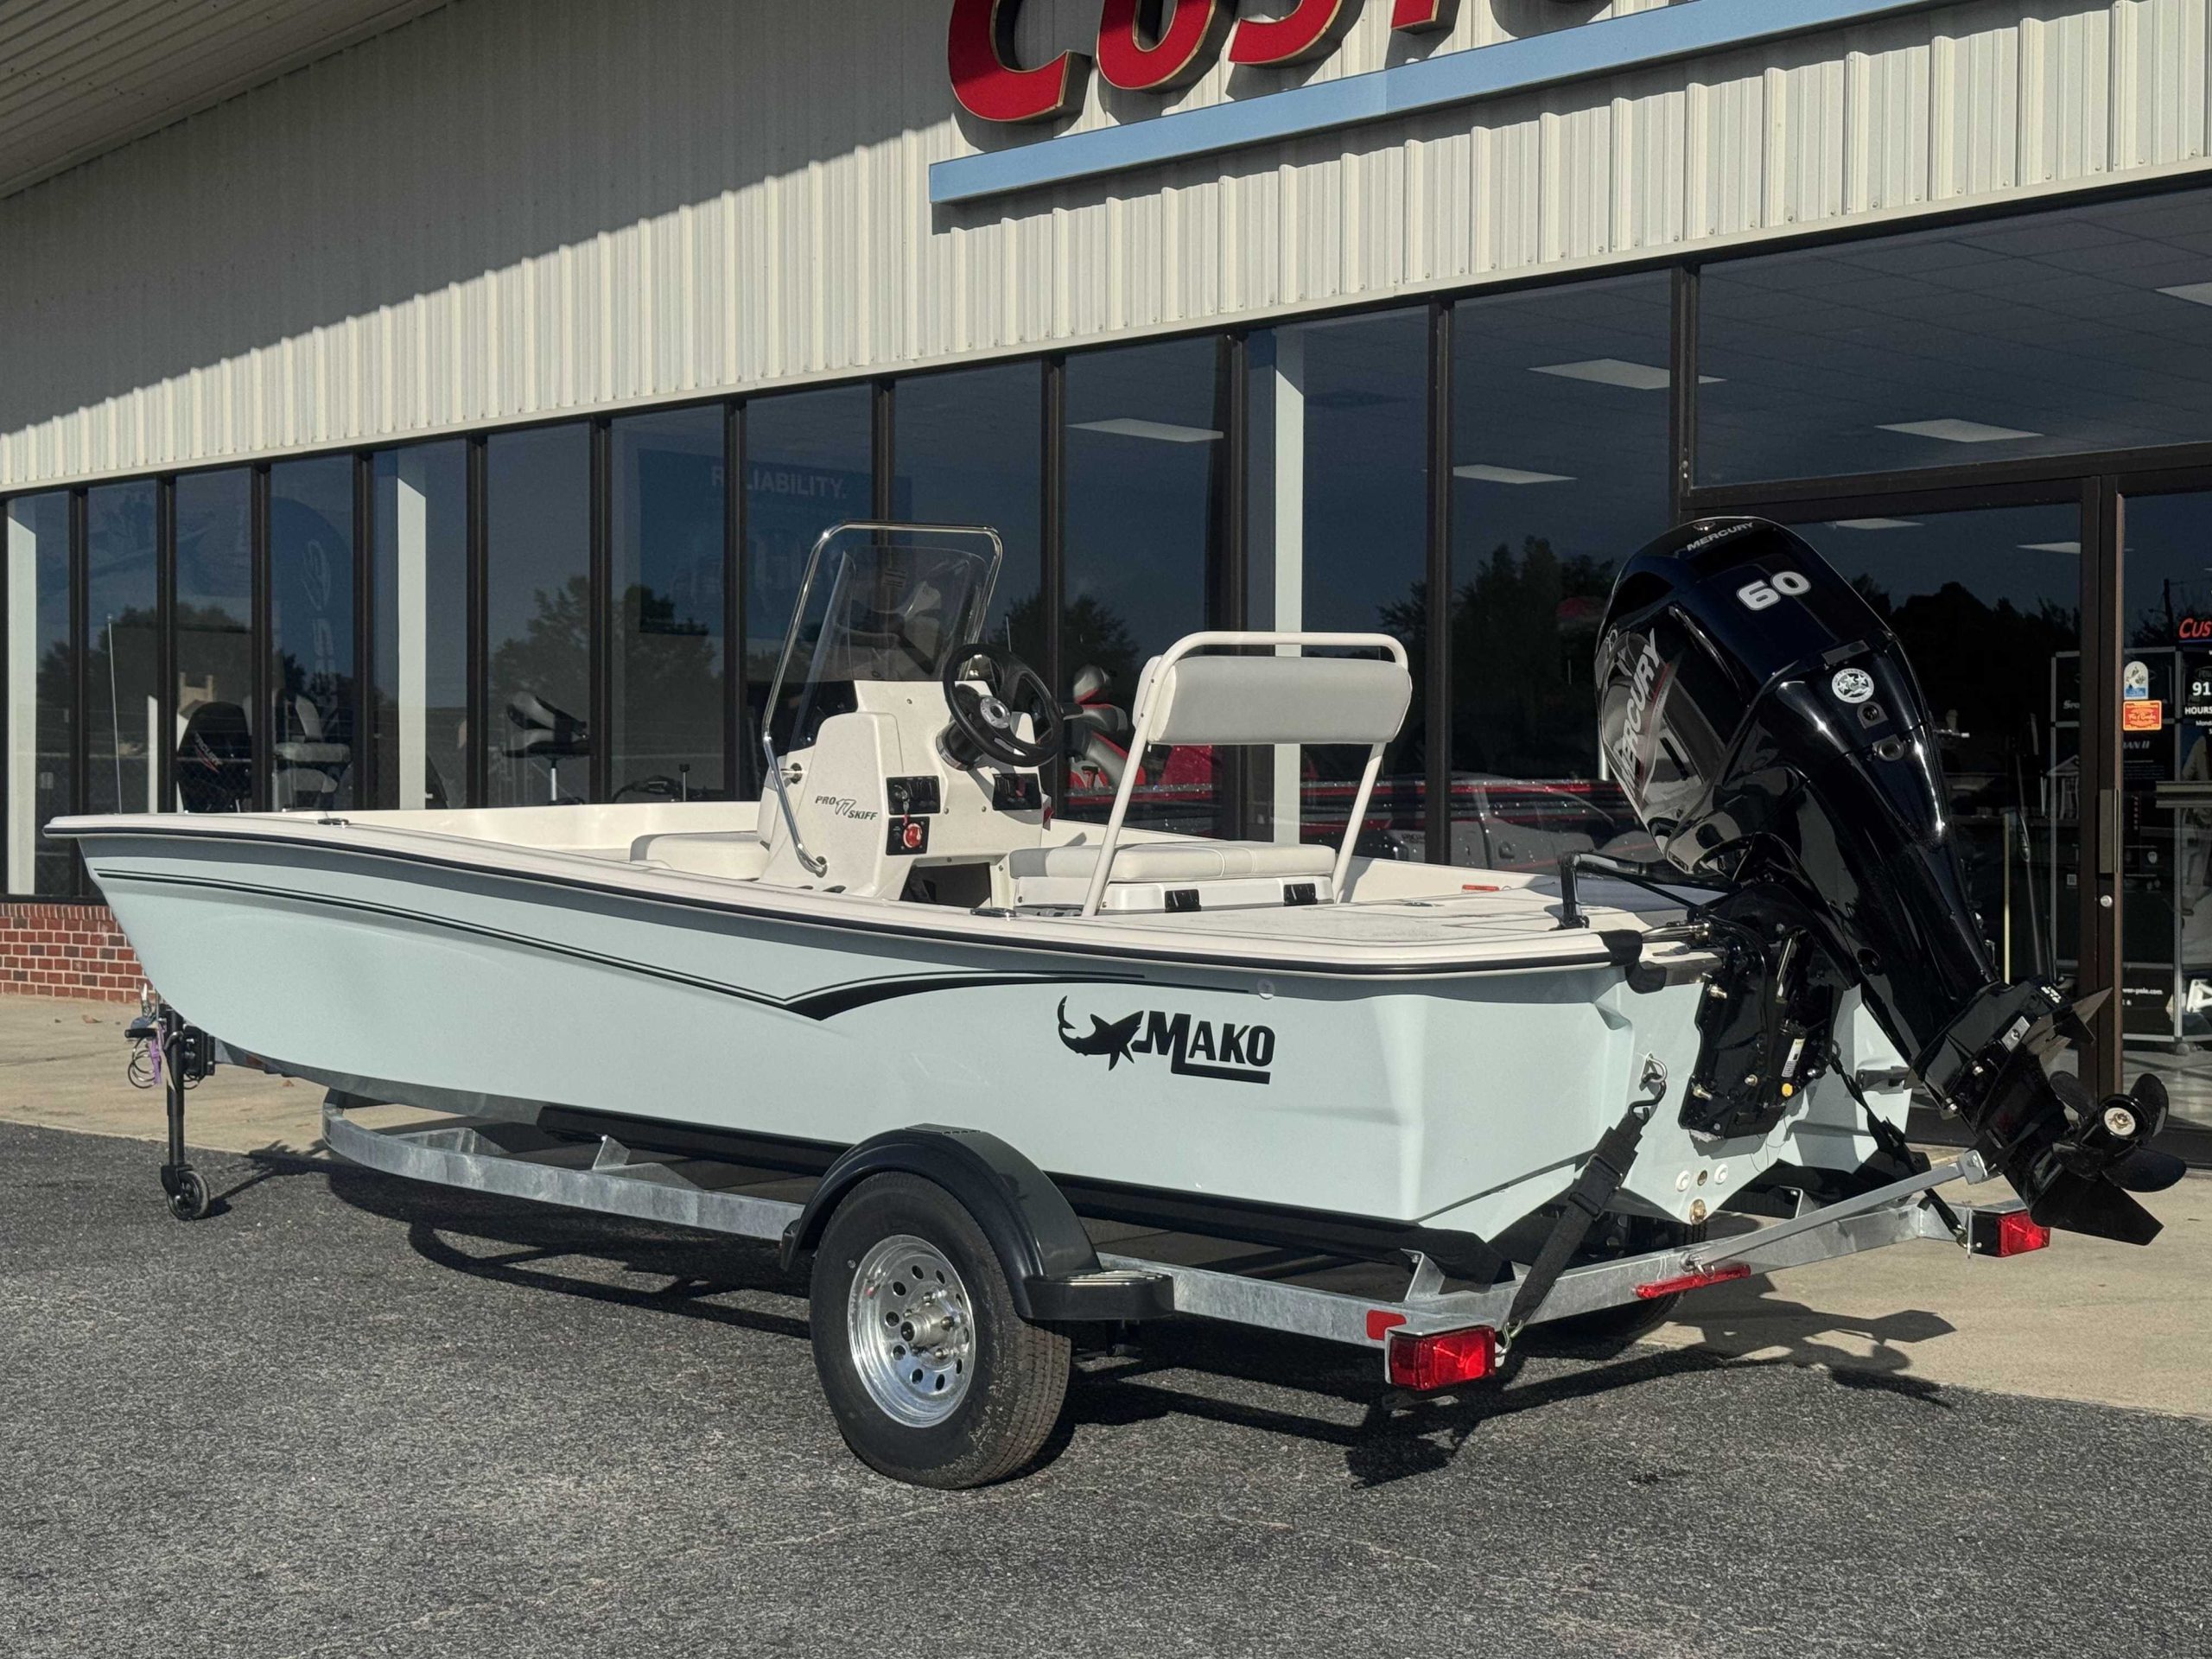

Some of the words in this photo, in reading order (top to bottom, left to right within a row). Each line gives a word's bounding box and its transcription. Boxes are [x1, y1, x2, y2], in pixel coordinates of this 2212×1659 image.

[710, 465, 847, 499] RIABILITY.
[1687, 522, 1753, 551] MERCURY
[1736, 571, 1811, 611] 60
[815, 795, 836, 805] PRO
[848, 810, 878, 821] SKIFF
[1130, 1009, 1276, 1085] MAKO
